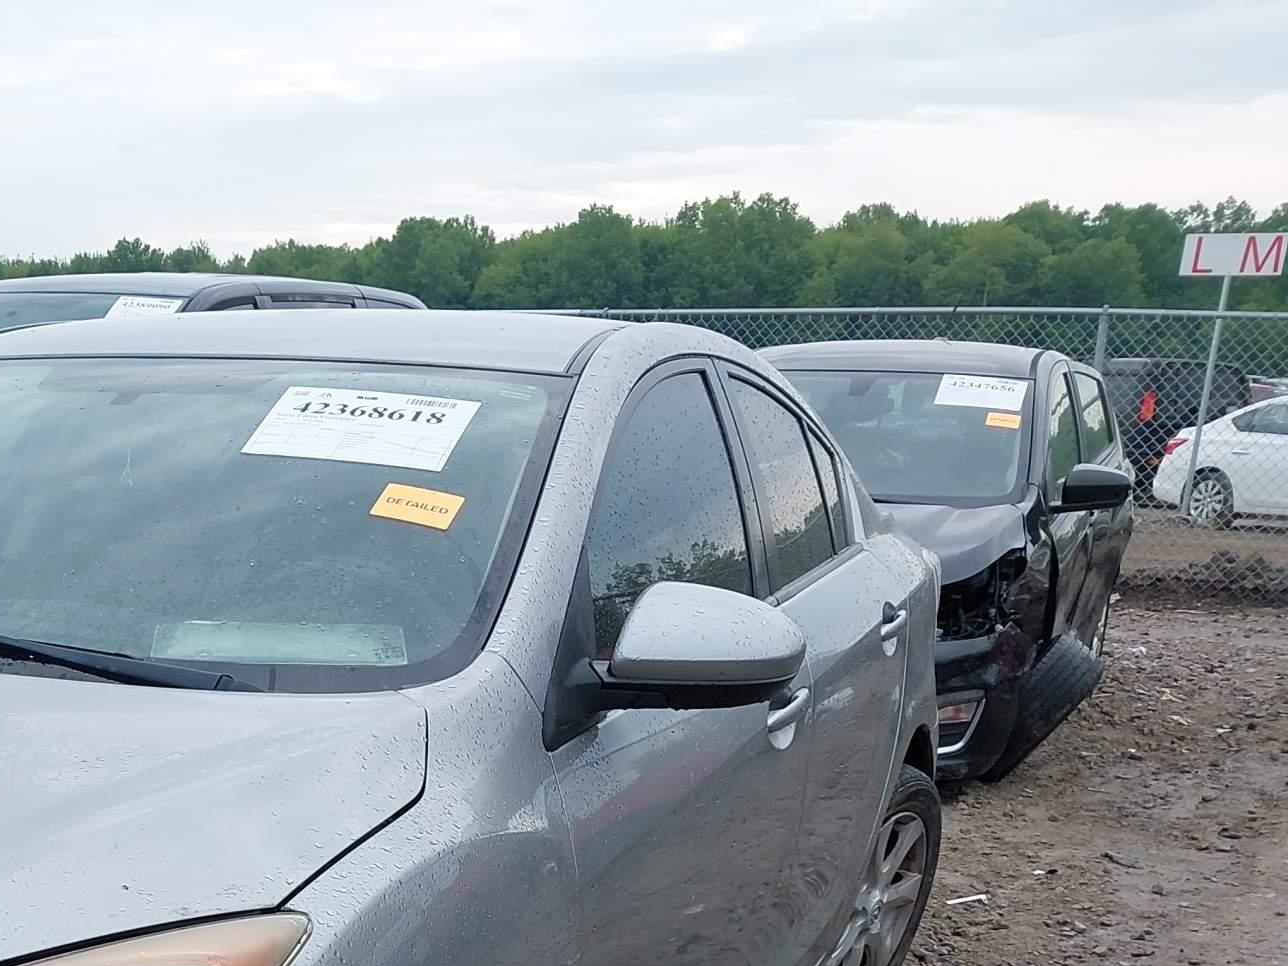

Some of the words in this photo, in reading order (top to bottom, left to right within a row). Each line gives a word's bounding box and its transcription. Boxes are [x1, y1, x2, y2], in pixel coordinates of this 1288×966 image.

[1191, 236, 1213, 274] L
[1239, 235, 1284, 274] M
[292, 401, 447, 425] 42368618
[385, 496, 449, 515] DETAILED
